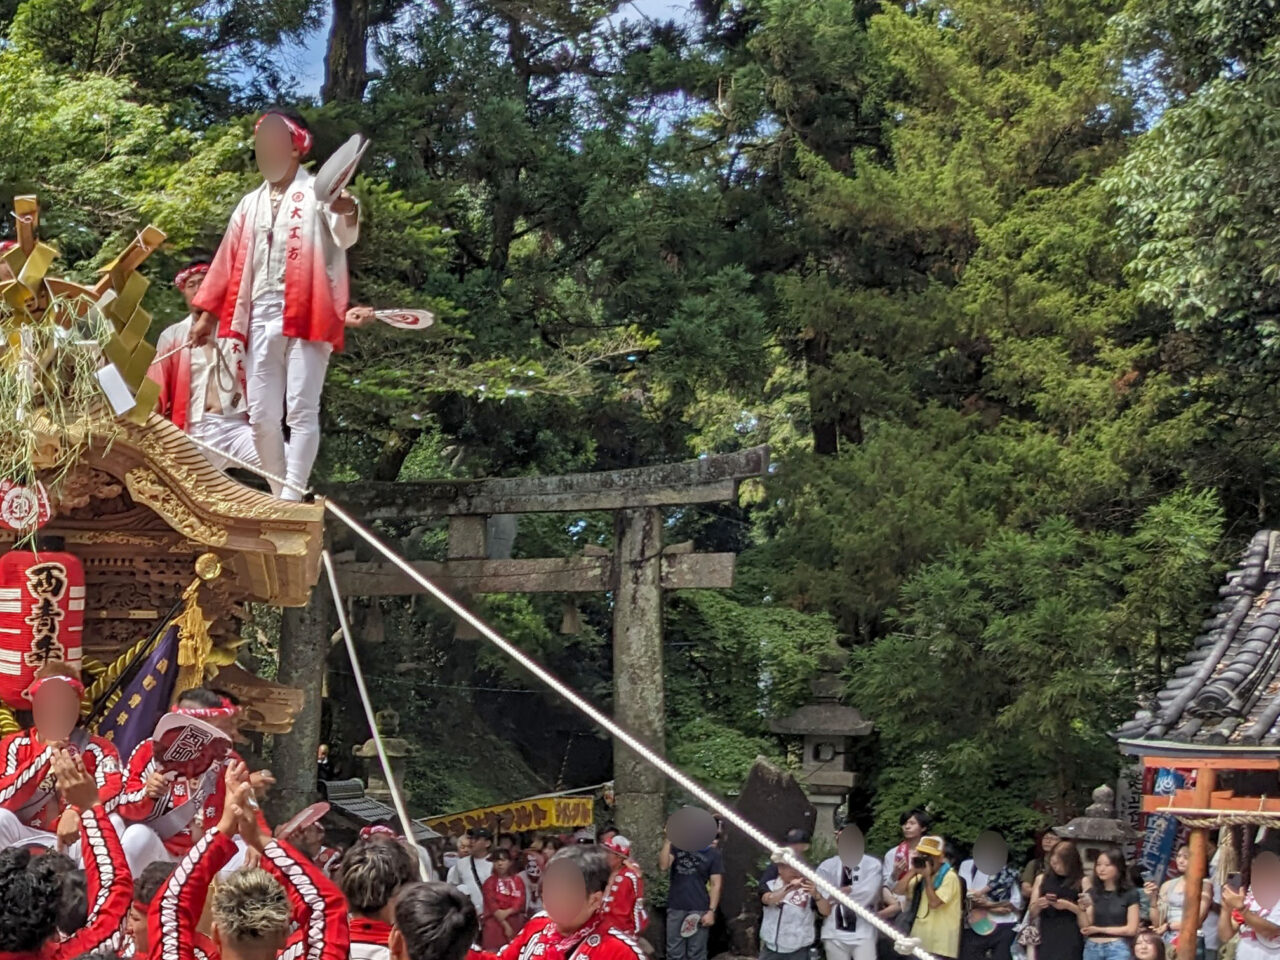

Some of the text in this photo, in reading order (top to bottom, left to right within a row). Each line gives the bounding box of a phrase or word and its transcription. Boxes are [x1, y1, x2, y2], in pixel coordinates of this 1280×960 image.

[287, 207, 304, 262] 大工方
[24, 561, 68, 684] 西青年
